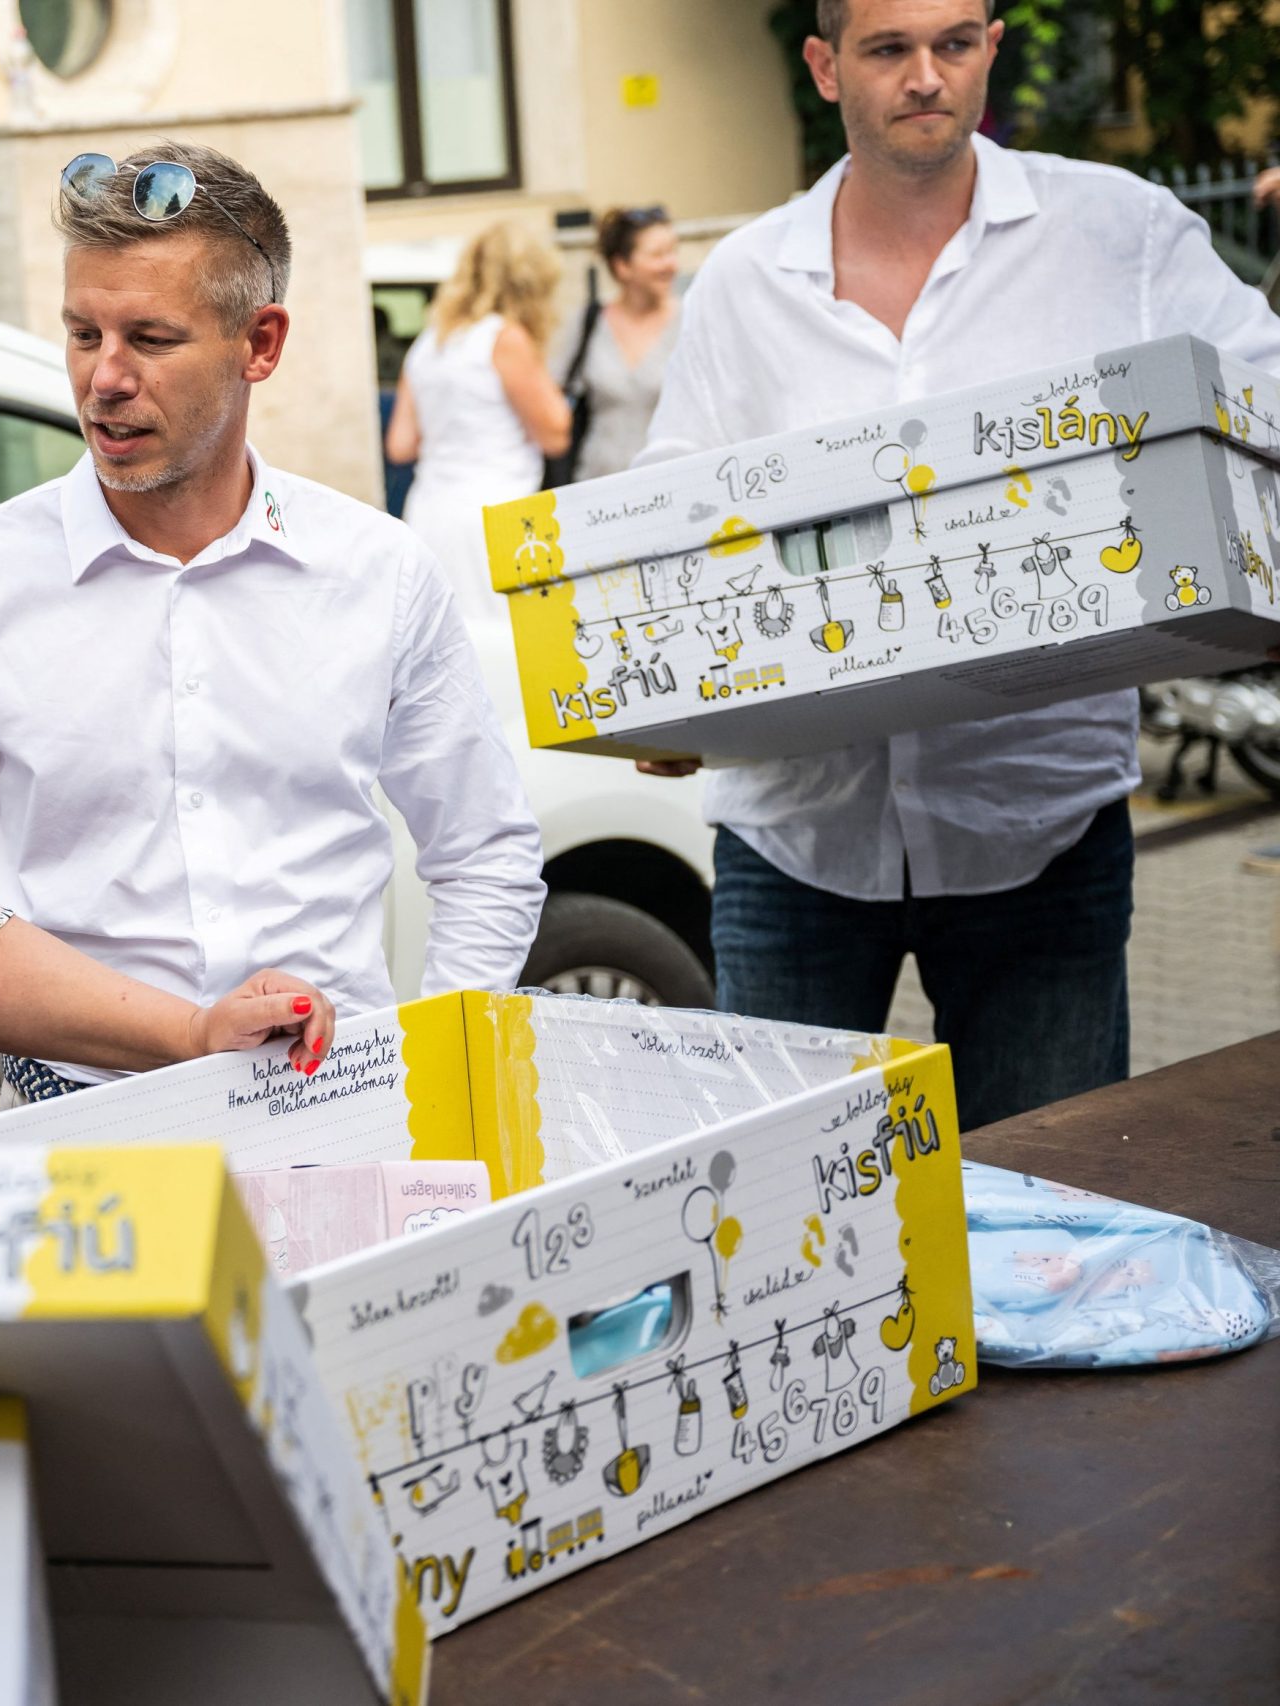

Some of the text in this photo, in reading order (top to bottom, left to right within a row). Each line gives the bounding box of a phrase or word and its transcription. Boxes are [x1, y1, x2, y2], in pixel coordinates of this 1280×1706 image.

[1043, 361, 1131, 398] boldogság
[826, 424, 887, 453] szeretet
[973, 395, 1150, 462] kislány
[945, 505, 995, 532] család
[829, 648, 897, 680] pillanat
[550, 652, 677, 729] kisfiú
[846, 1076, 915, 1120] boldogság
[812, 1093, 941, 1215] kisfiú
[402, 1180, 477, 1199] Stilleinlagen
[634, 1157, 696, 1200] szeretet
[743, 1266, 793, 1306] család
[637, 1475, 707, 1532] pillanat
